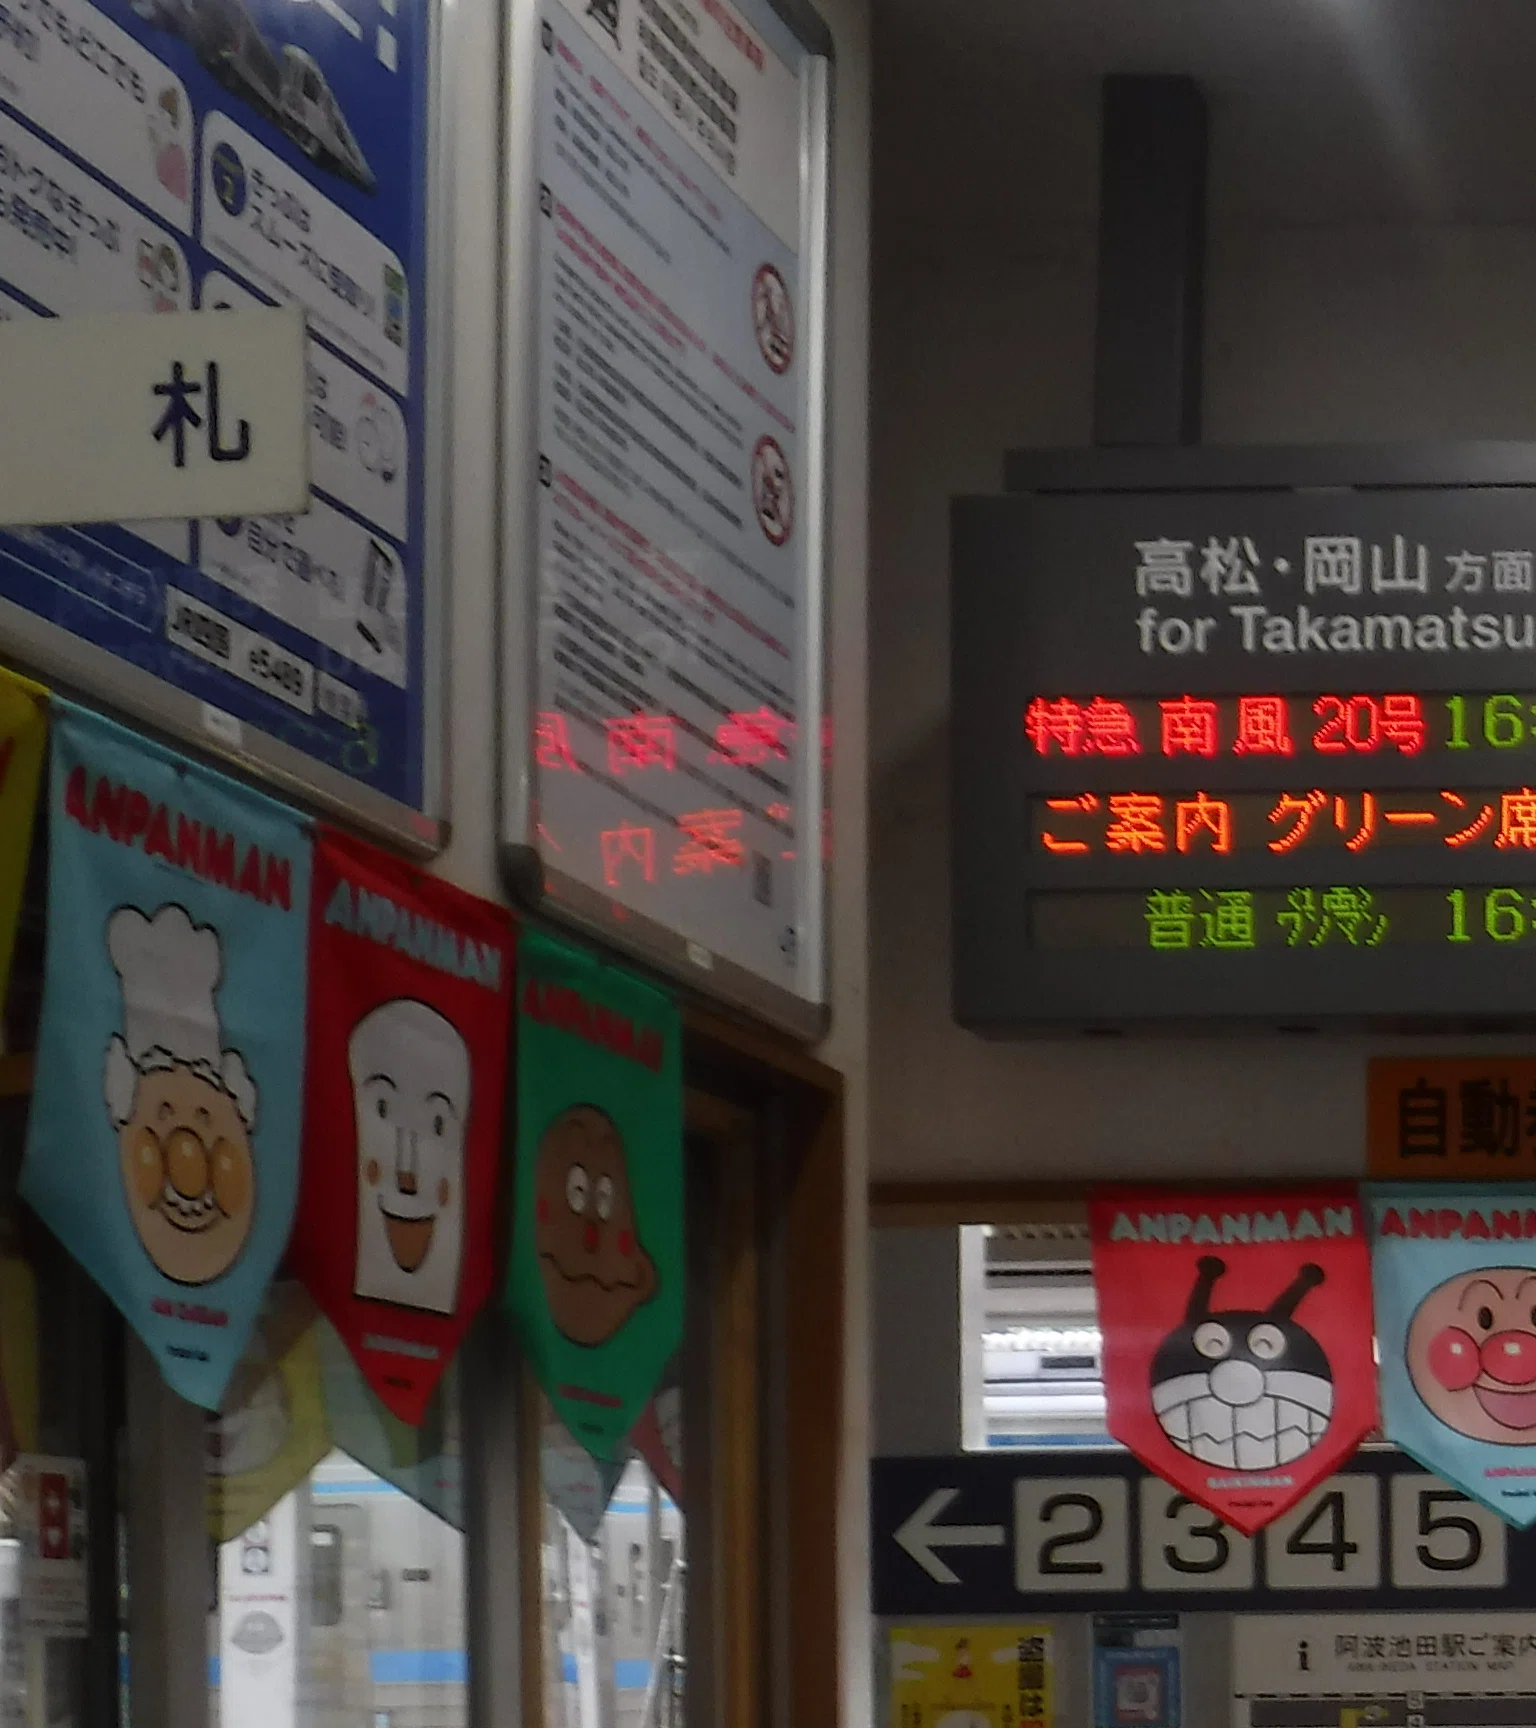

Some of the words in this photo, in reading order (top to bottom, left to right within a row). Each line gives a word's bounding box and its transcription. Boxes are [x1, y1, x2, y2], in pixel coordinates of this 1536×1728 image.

[151, 361, 250, 468] 札
[1134, 536, 1430, 599] 高松・岡山
[1445, 550, 1536, 594] 方面
[1137, 606, 1216, 654] for
[1023, 693, 1141, 757] 特急
[1311, 693, 1427, 755] 20号
[64, 762, 293, 912] ANPANMAN
[1040, 788, 1231, 855] ご案内
[324, 878, 502, 993] ANPANMAN
[1143, 886, 1257, 950] 普通
[1109, 1206, 1355, 1245] ANPANMAN
[1038, 1493, 1105, 1575] 2
[1163, 1493, 1230, 1574] 3
[1286, 1490, 1359, 1573] 4
[1416, 1490, 1486, 1573] 5
